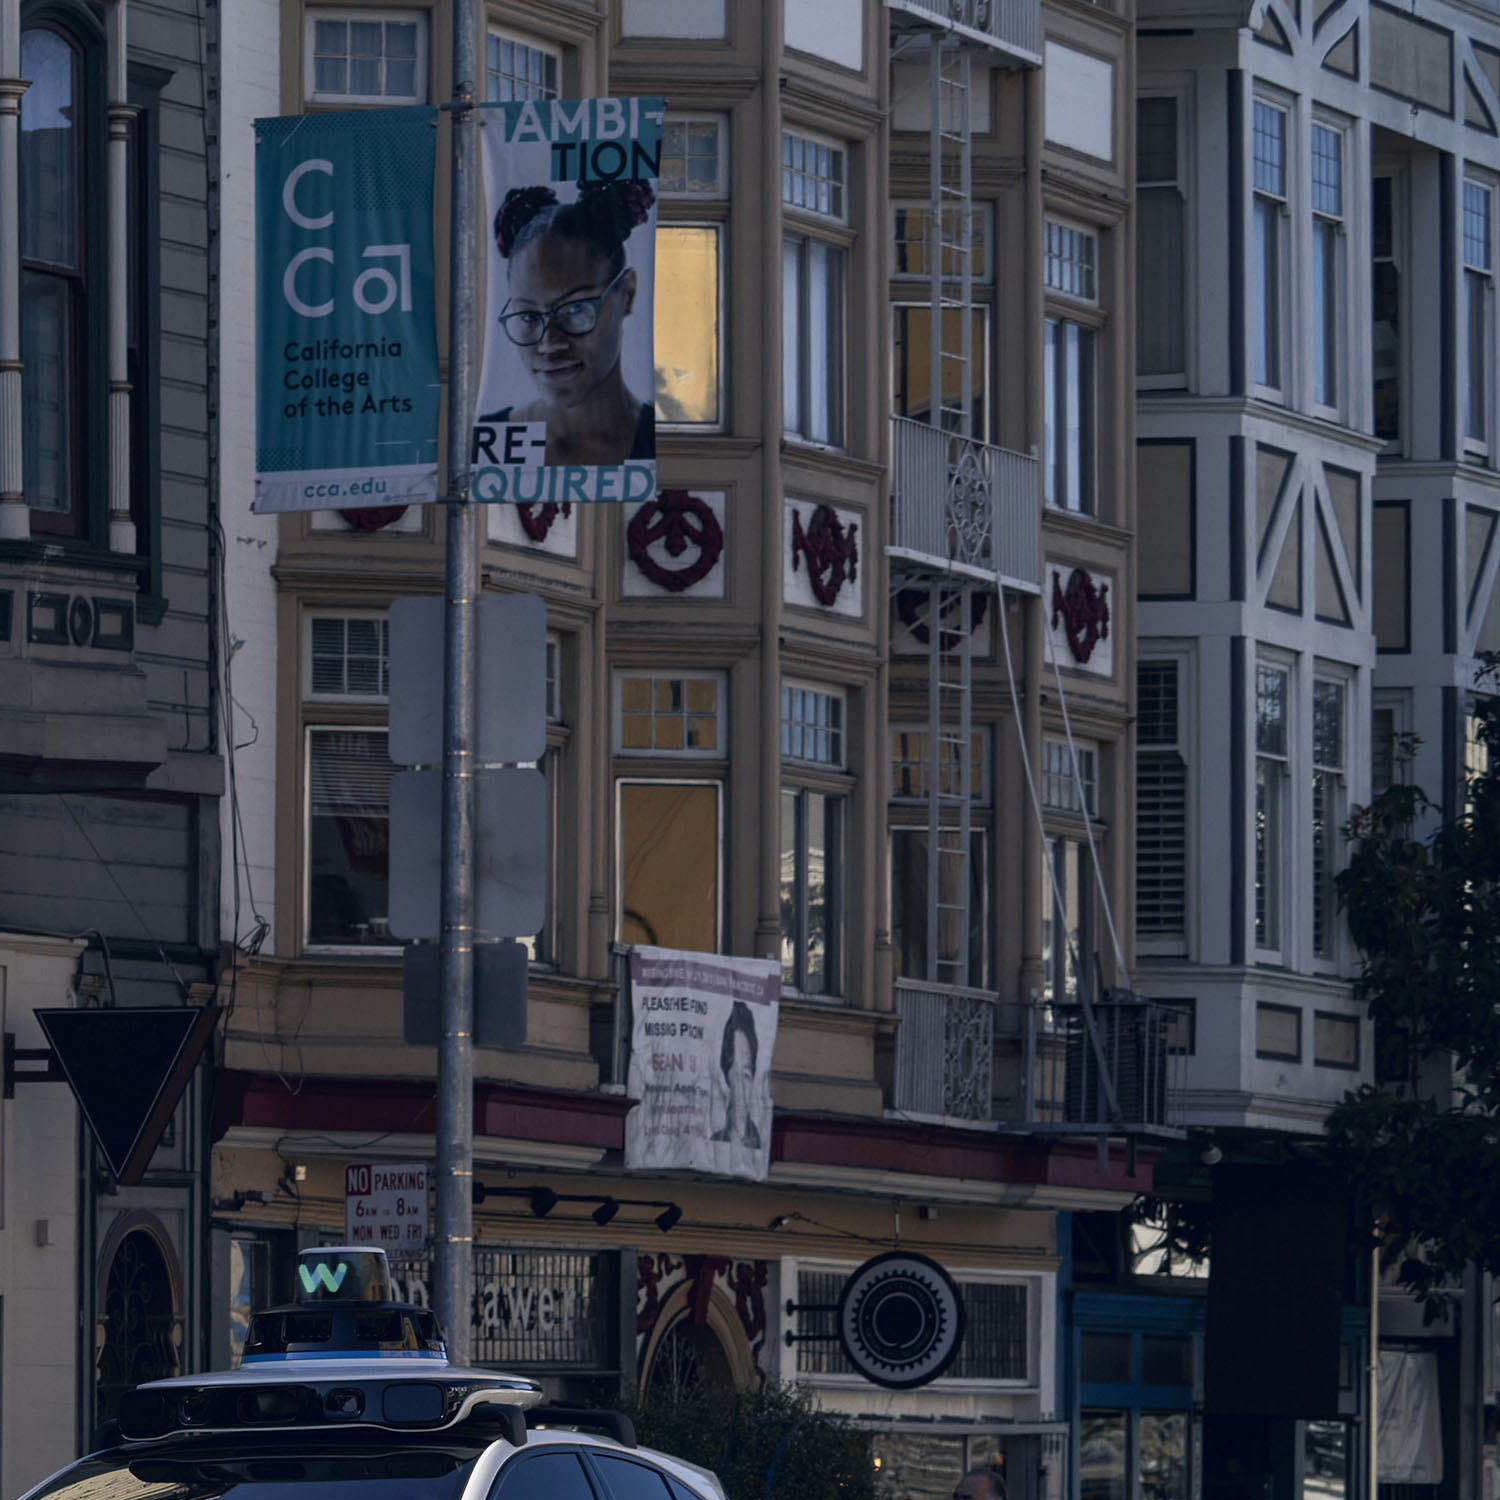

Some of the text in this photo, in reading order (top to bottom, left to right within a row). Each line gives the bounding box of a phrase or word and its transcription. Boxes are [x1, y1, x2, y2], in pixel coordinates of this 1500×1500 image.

[551, 140, 662, 183] TION
[284, 336, 402, 362] California
[284, 369, 370, 393] College
[284, 394, 413, 418] of the Arts
[472, 426, 546, 464] RE-
[304, 477, 387, 498] cca.edu
[472, 465, 654, 503] QUIRED
[348, 1167, 424, 1193] NO PARKING
[353, 1223, 423, 1241] MON WED FRI
